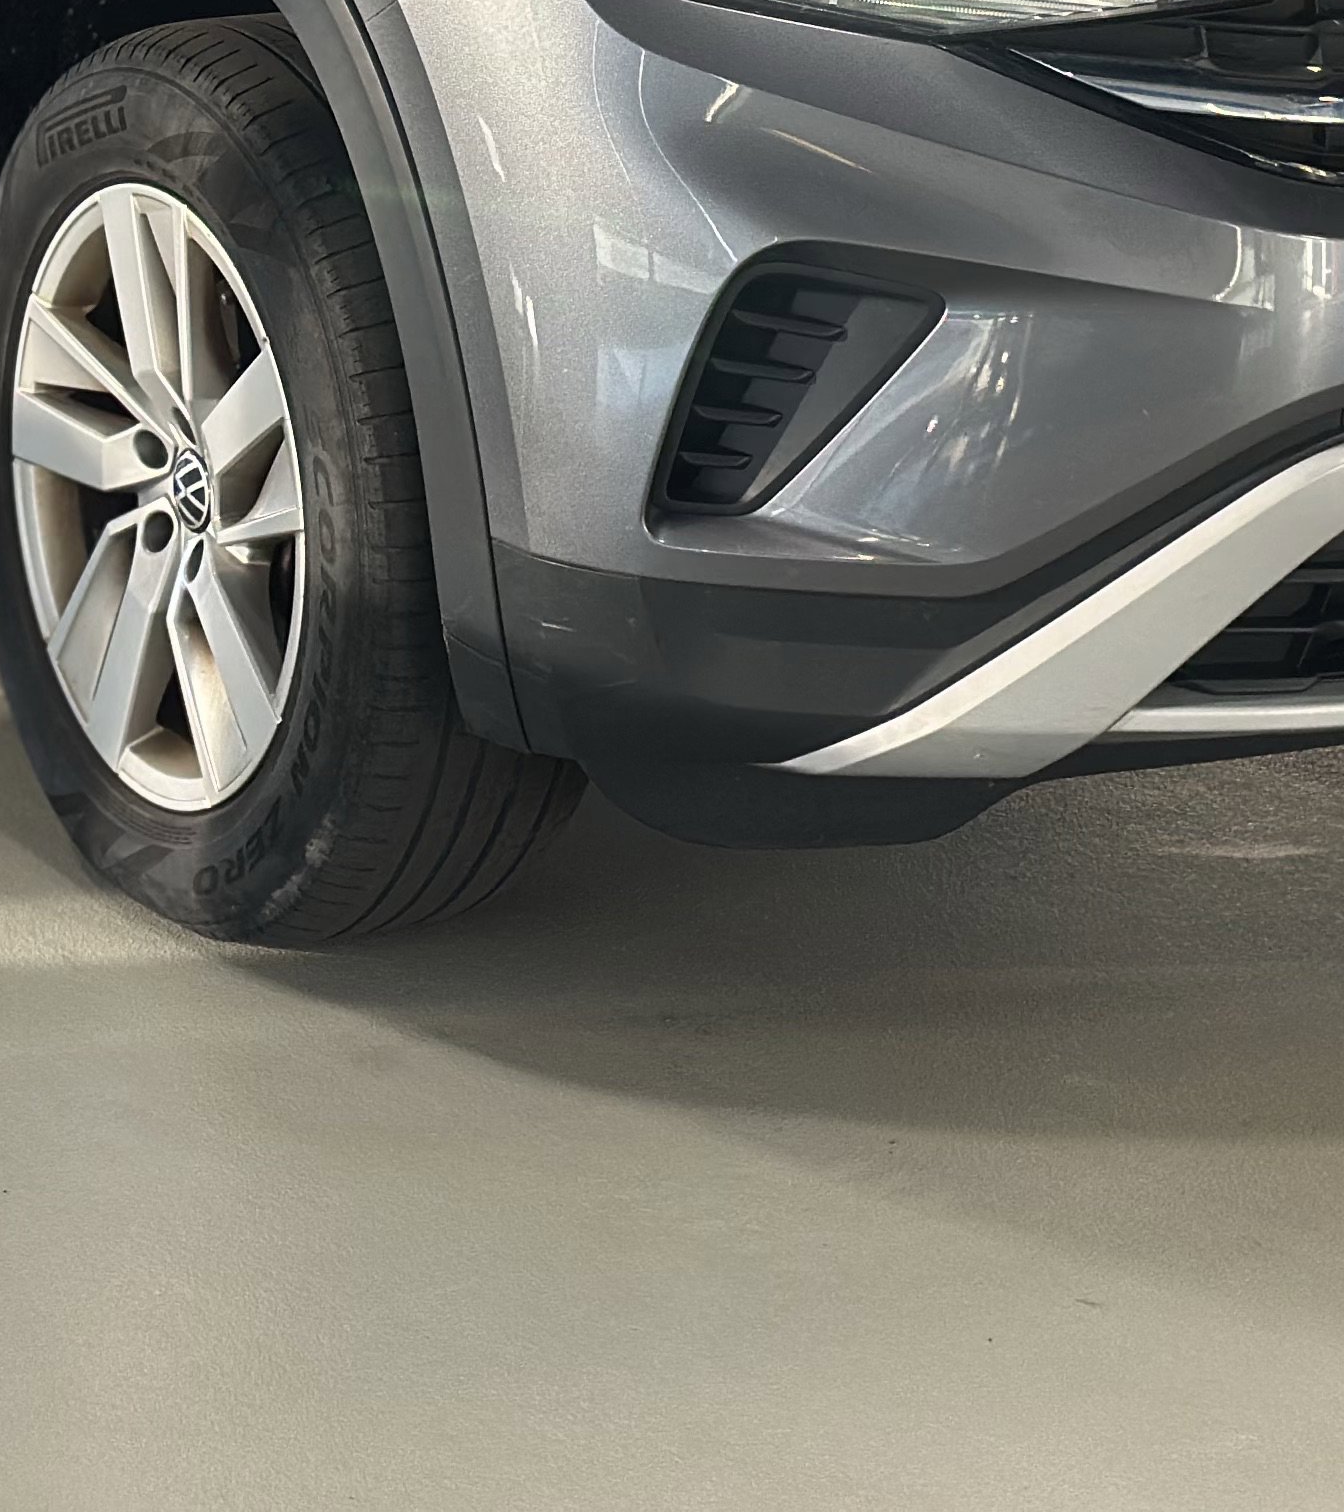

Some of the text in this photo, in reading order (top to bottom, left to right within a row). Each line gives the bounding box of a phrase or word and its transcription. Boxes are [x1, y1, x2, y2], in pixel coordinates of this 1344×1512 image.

[36, 85, 128, 168] PIRELLI
[193, 403, 338, 897] SCORPION ZERO
